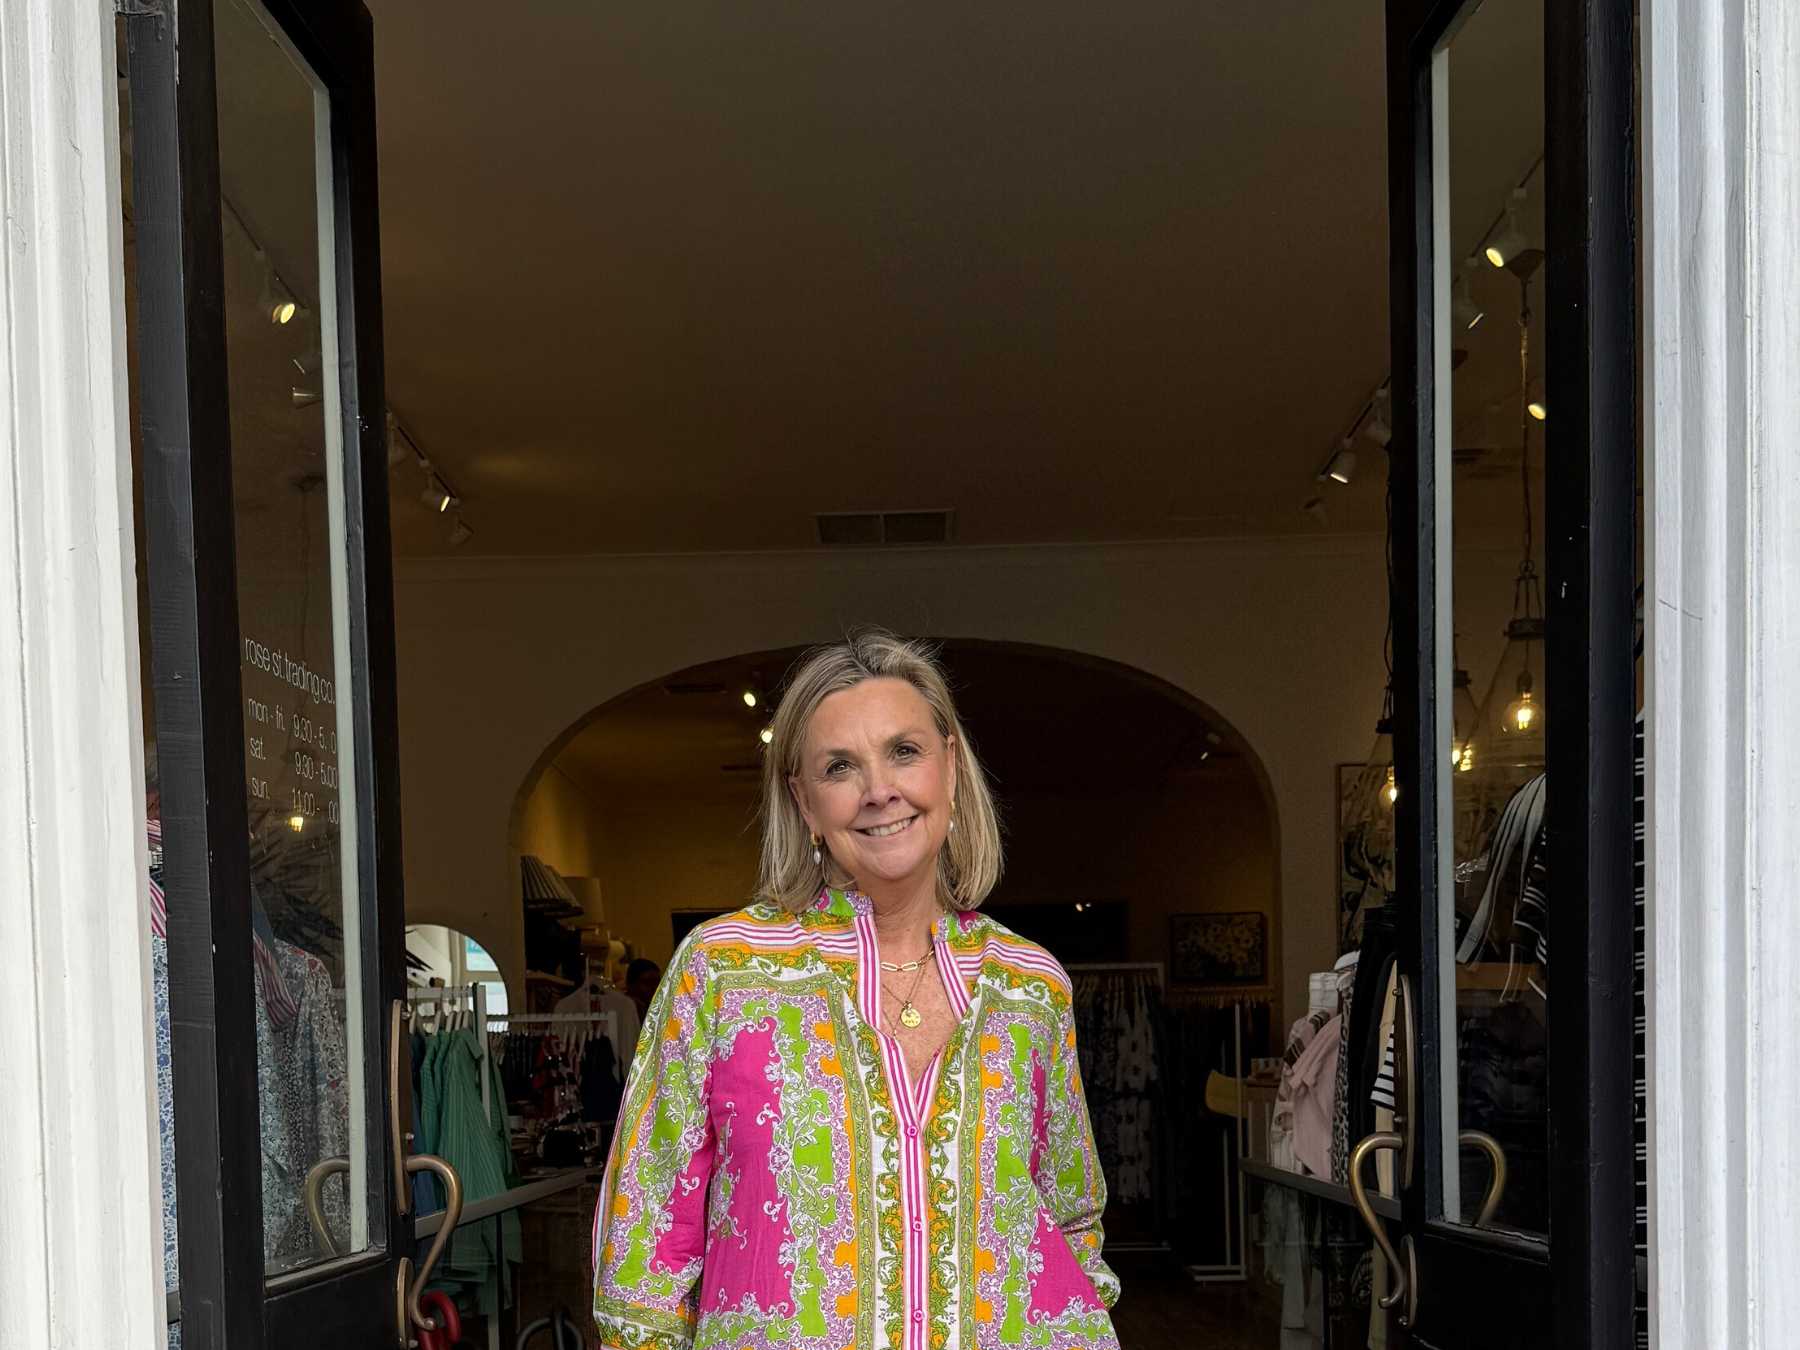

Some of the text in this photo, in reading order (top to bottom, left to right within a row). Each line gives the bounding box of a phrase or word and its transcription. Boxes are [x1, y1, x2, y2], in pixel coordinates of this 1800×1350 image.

[245, 637, 270, 672] rose
[285, 652, 320, 704] trading
[320, 678, 336, 704] co.
[248, 698, 268, 725] mon
[293, 714, 312, 743] 9.30
[318, 726, 337, 754] 5.0
[250, 736, 266, 760] sat.
[295, 751, 314, 780] 9.30
[251, 777, 270, 800] sun.
